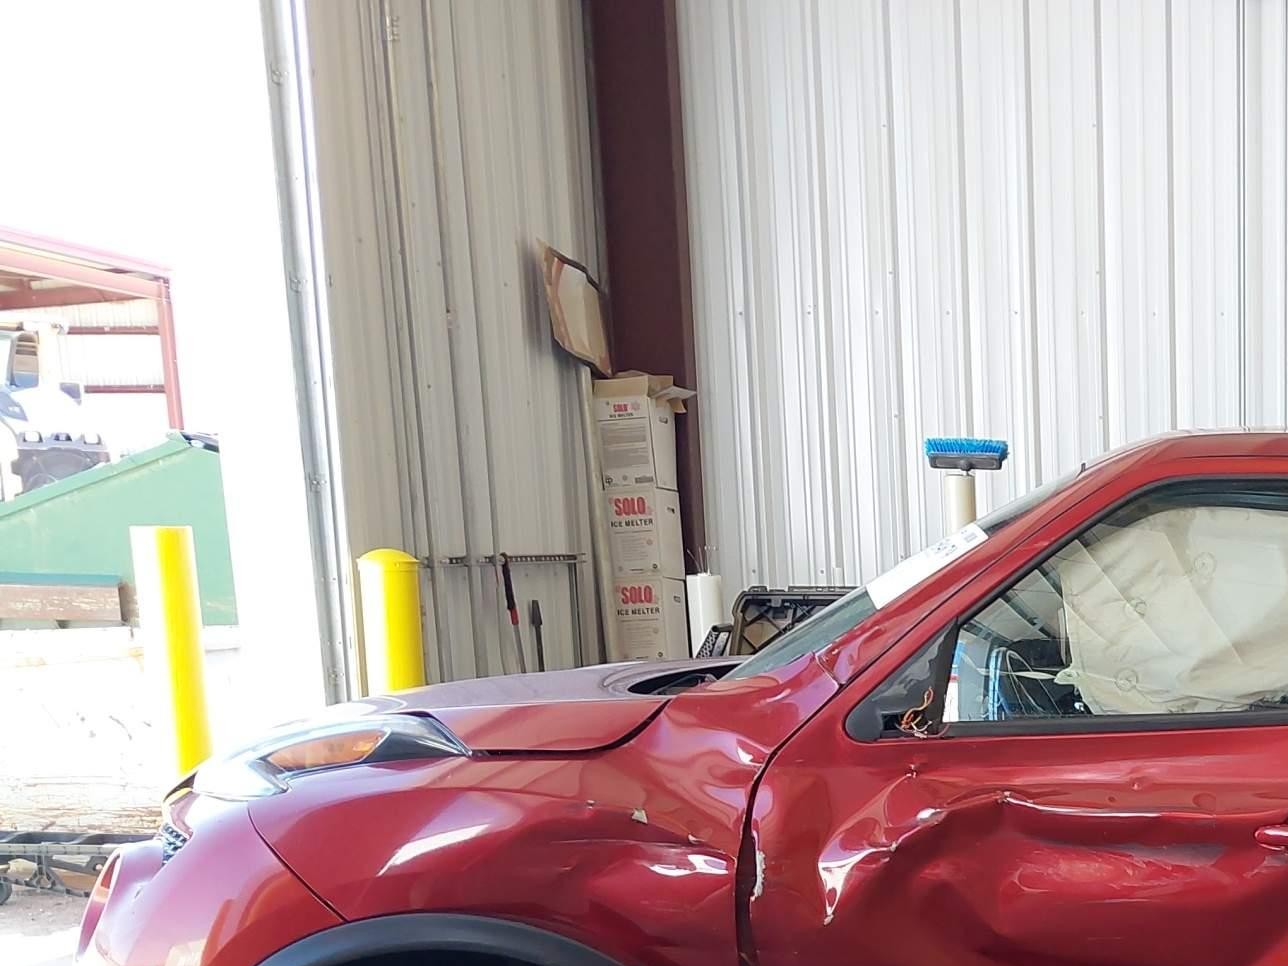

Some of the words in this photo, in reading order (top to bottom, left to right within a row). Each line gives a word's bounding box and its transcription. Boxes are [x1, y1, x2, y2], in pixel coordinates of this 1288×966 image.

[614, 496, 646, 516] SOLO
[610, 520, 623, 528] ICE
[624, 518, 654, 527] MELTER
[621, 585, 653, 605] SOLO
[617, 608, 630, 616] ICE
[631, 606, 660, 615] MELTER
